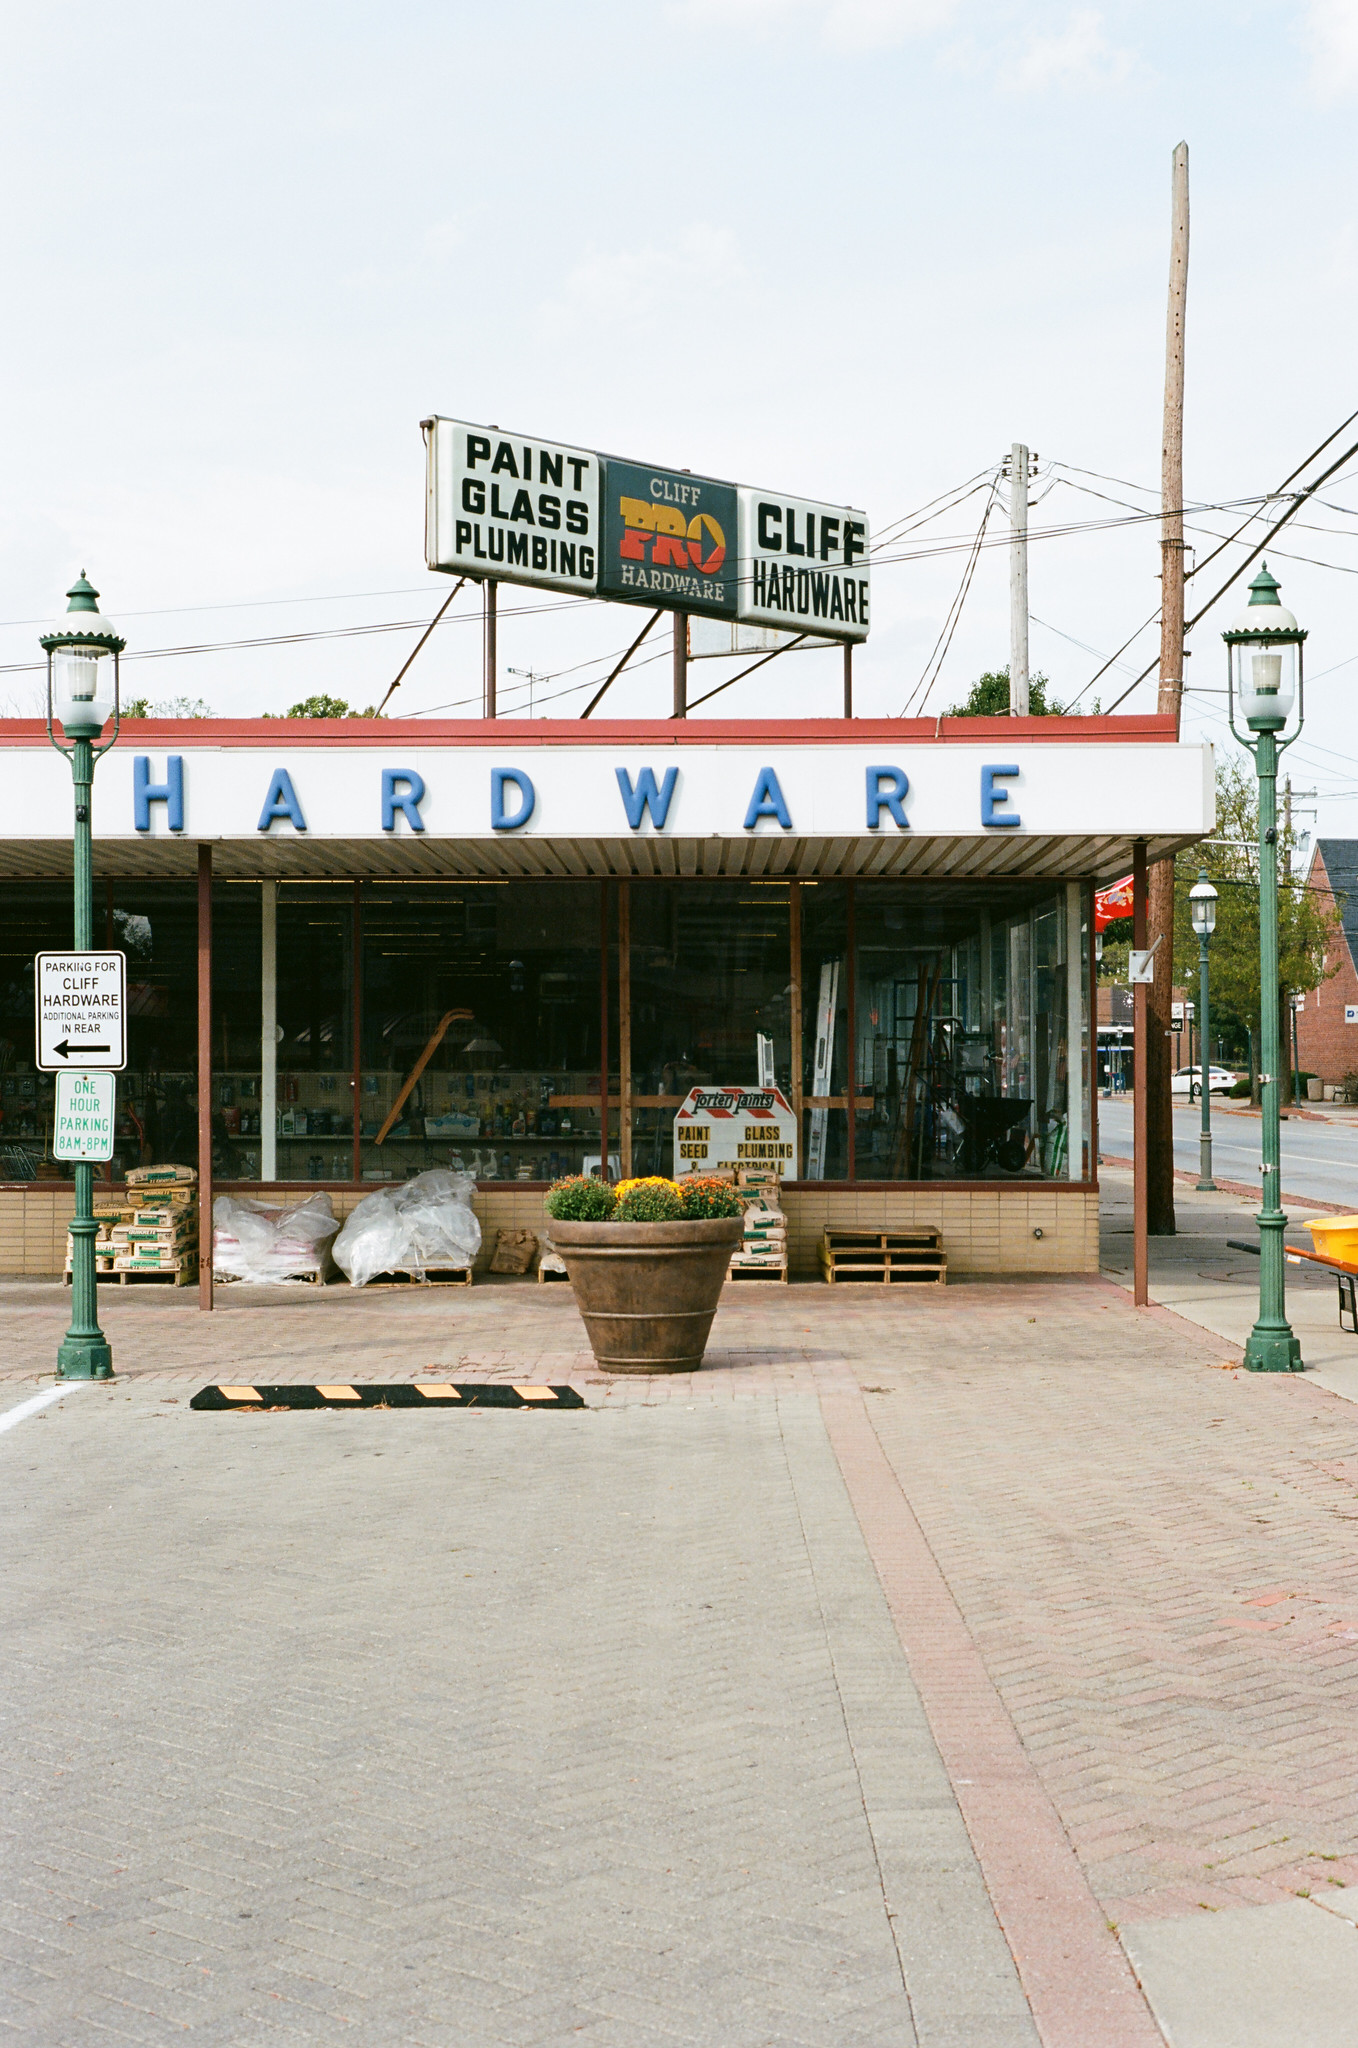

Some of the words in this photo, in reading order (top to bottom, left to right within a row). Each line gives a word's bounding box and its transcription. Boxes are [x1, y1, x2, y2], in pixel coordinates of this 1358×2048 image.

[467, 434, 589, 491] PAINT
[650, 478, 701, 506] CLIFF
[462, 478, 589, 535] GLASS
[620, 496, 726, 575] PRO
[758, 502, 865, 566] CLIFF
[455, 520, 595, 579] PLUMBING
[621, 564, 725, 602] HARDWARE
[754, 559, 869, 625] HARDWARE
[134, 755, 1021, 832] HARDWARE
[45, 962, 92, 972] PARKING
[95, 962, 116, 972] FOR
[62, 977, 99, 990] CLIFF
[43, 994, 119, 1007] HARDWARE
[43, 1011, 86, 1021] ADDITIONAL
[88, 1011, 120, 1020] PARKING
[62, 1024, 71, 1034] IN
[74, 1023, 101, 1033] REAR
[74, 1081, 96, 1095] ONE
[70, 1098, 100, 1112] HOUR
[60, 1117, 109, 1132] PARKING
[678, 1126, 710, 1141] PAINT
[745, 1126, 780, 1141] GLASS
[59, 1136, 108, 1151] 8AM-8PM
[680, 1143, 708, 1158] SEED
[737, 1143, 793, 1158] PLUMBING
